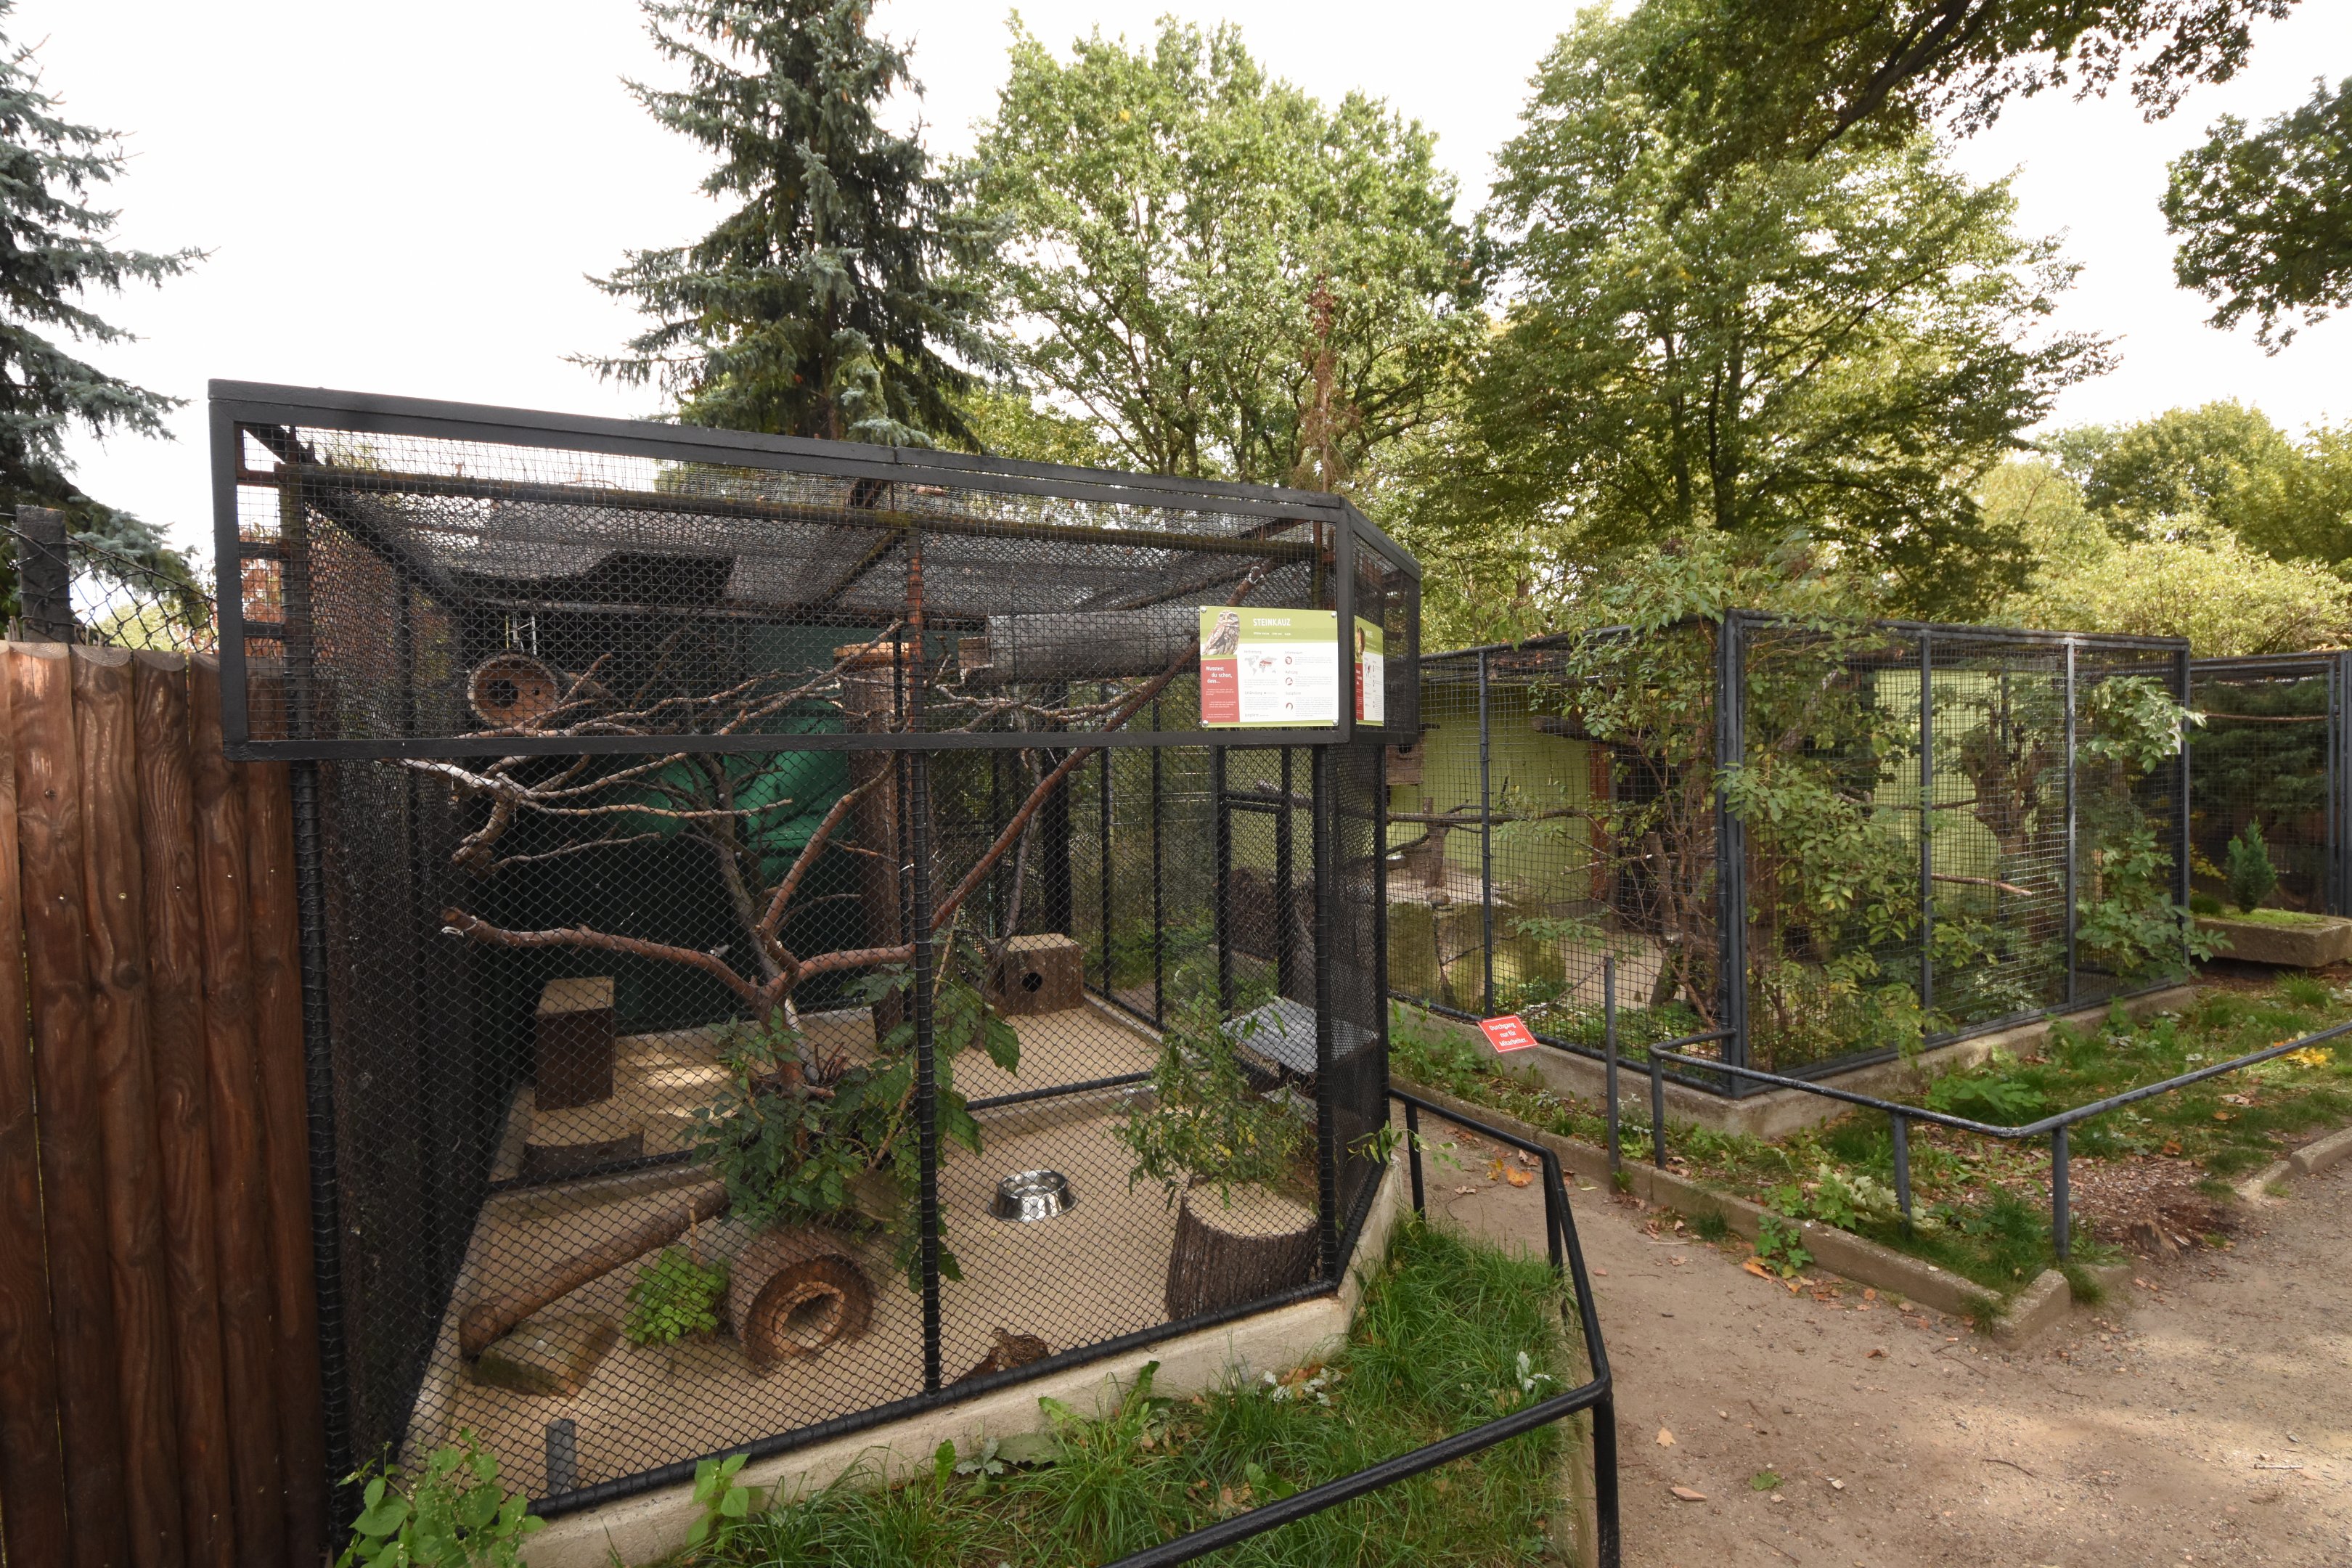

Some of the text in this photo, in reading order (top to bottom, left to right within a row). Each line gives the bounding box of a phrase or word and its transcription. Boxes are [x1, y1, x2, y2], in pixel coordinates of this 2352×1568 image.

[1253, 618, 1291, 626] STEINKAUZ
[1489, 1022, 1516, 1031] Durchgang
[1499, 1038, 1528, 1047] Mitarbeiter.
